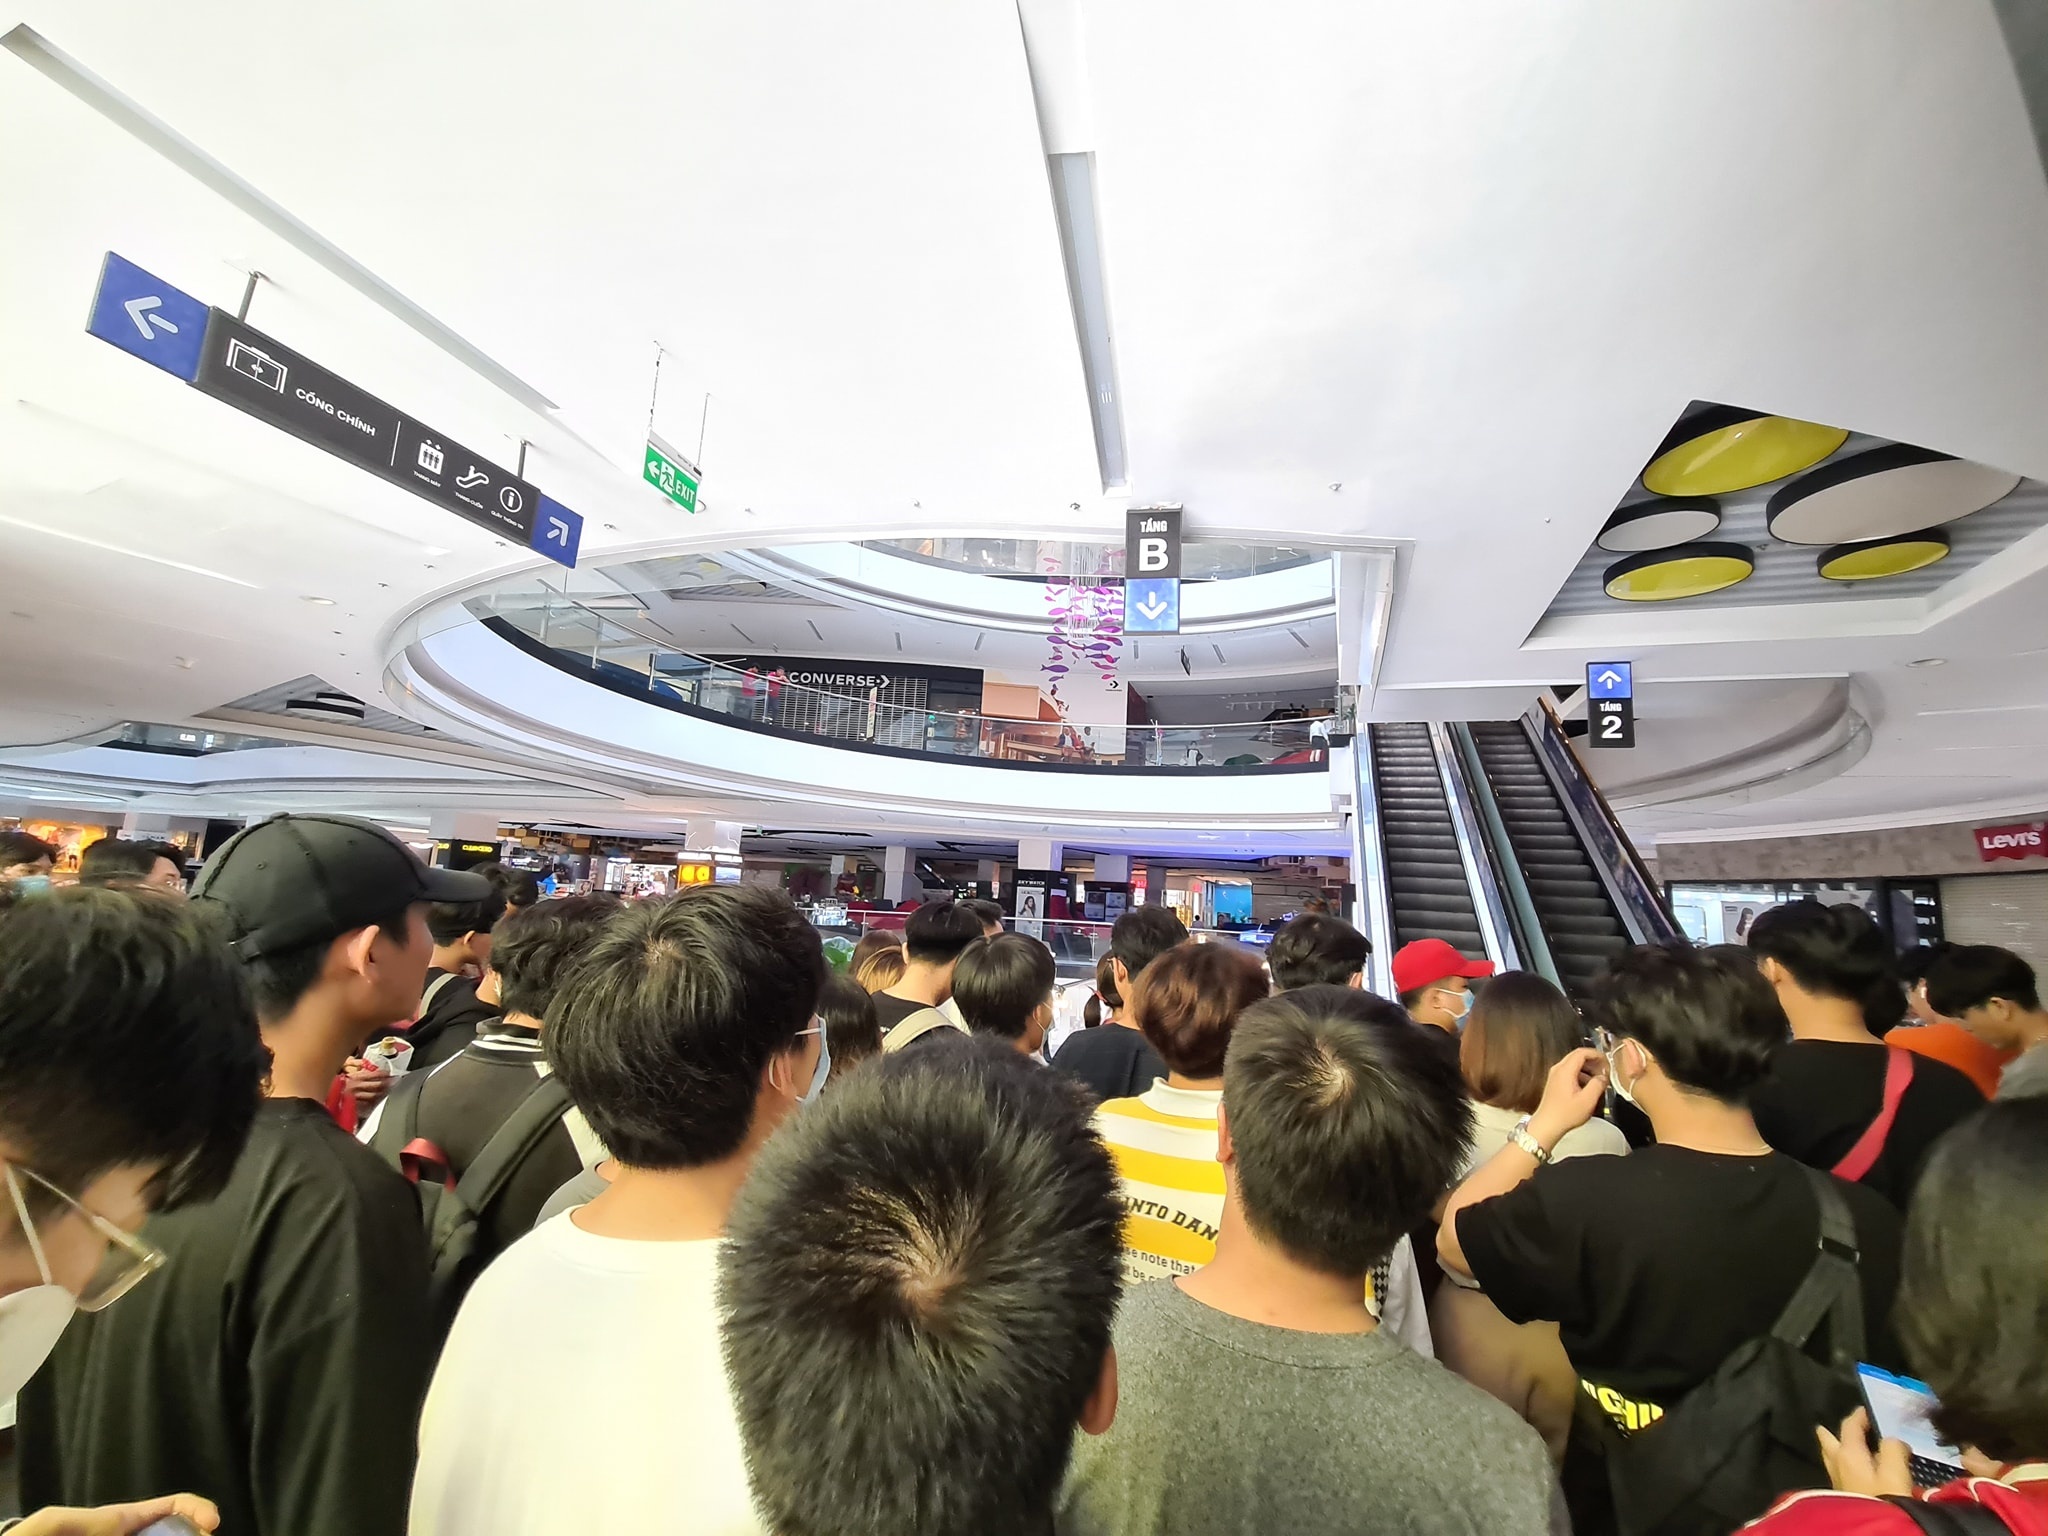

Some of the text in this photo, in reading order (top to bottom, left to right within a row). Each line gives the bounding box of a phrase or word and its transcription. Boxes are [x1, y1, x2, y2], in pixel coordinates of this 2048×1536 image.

[337, 410, 376, 436] CHÍNH
[675, 479, 695, 504] EXIT
[1139, 537, 1169, 571] B
[789, 672, 875, 687] CONVERSE
[1601, 715, 1623, 739] 2
[1140, 1252, 1168, 1268] note
